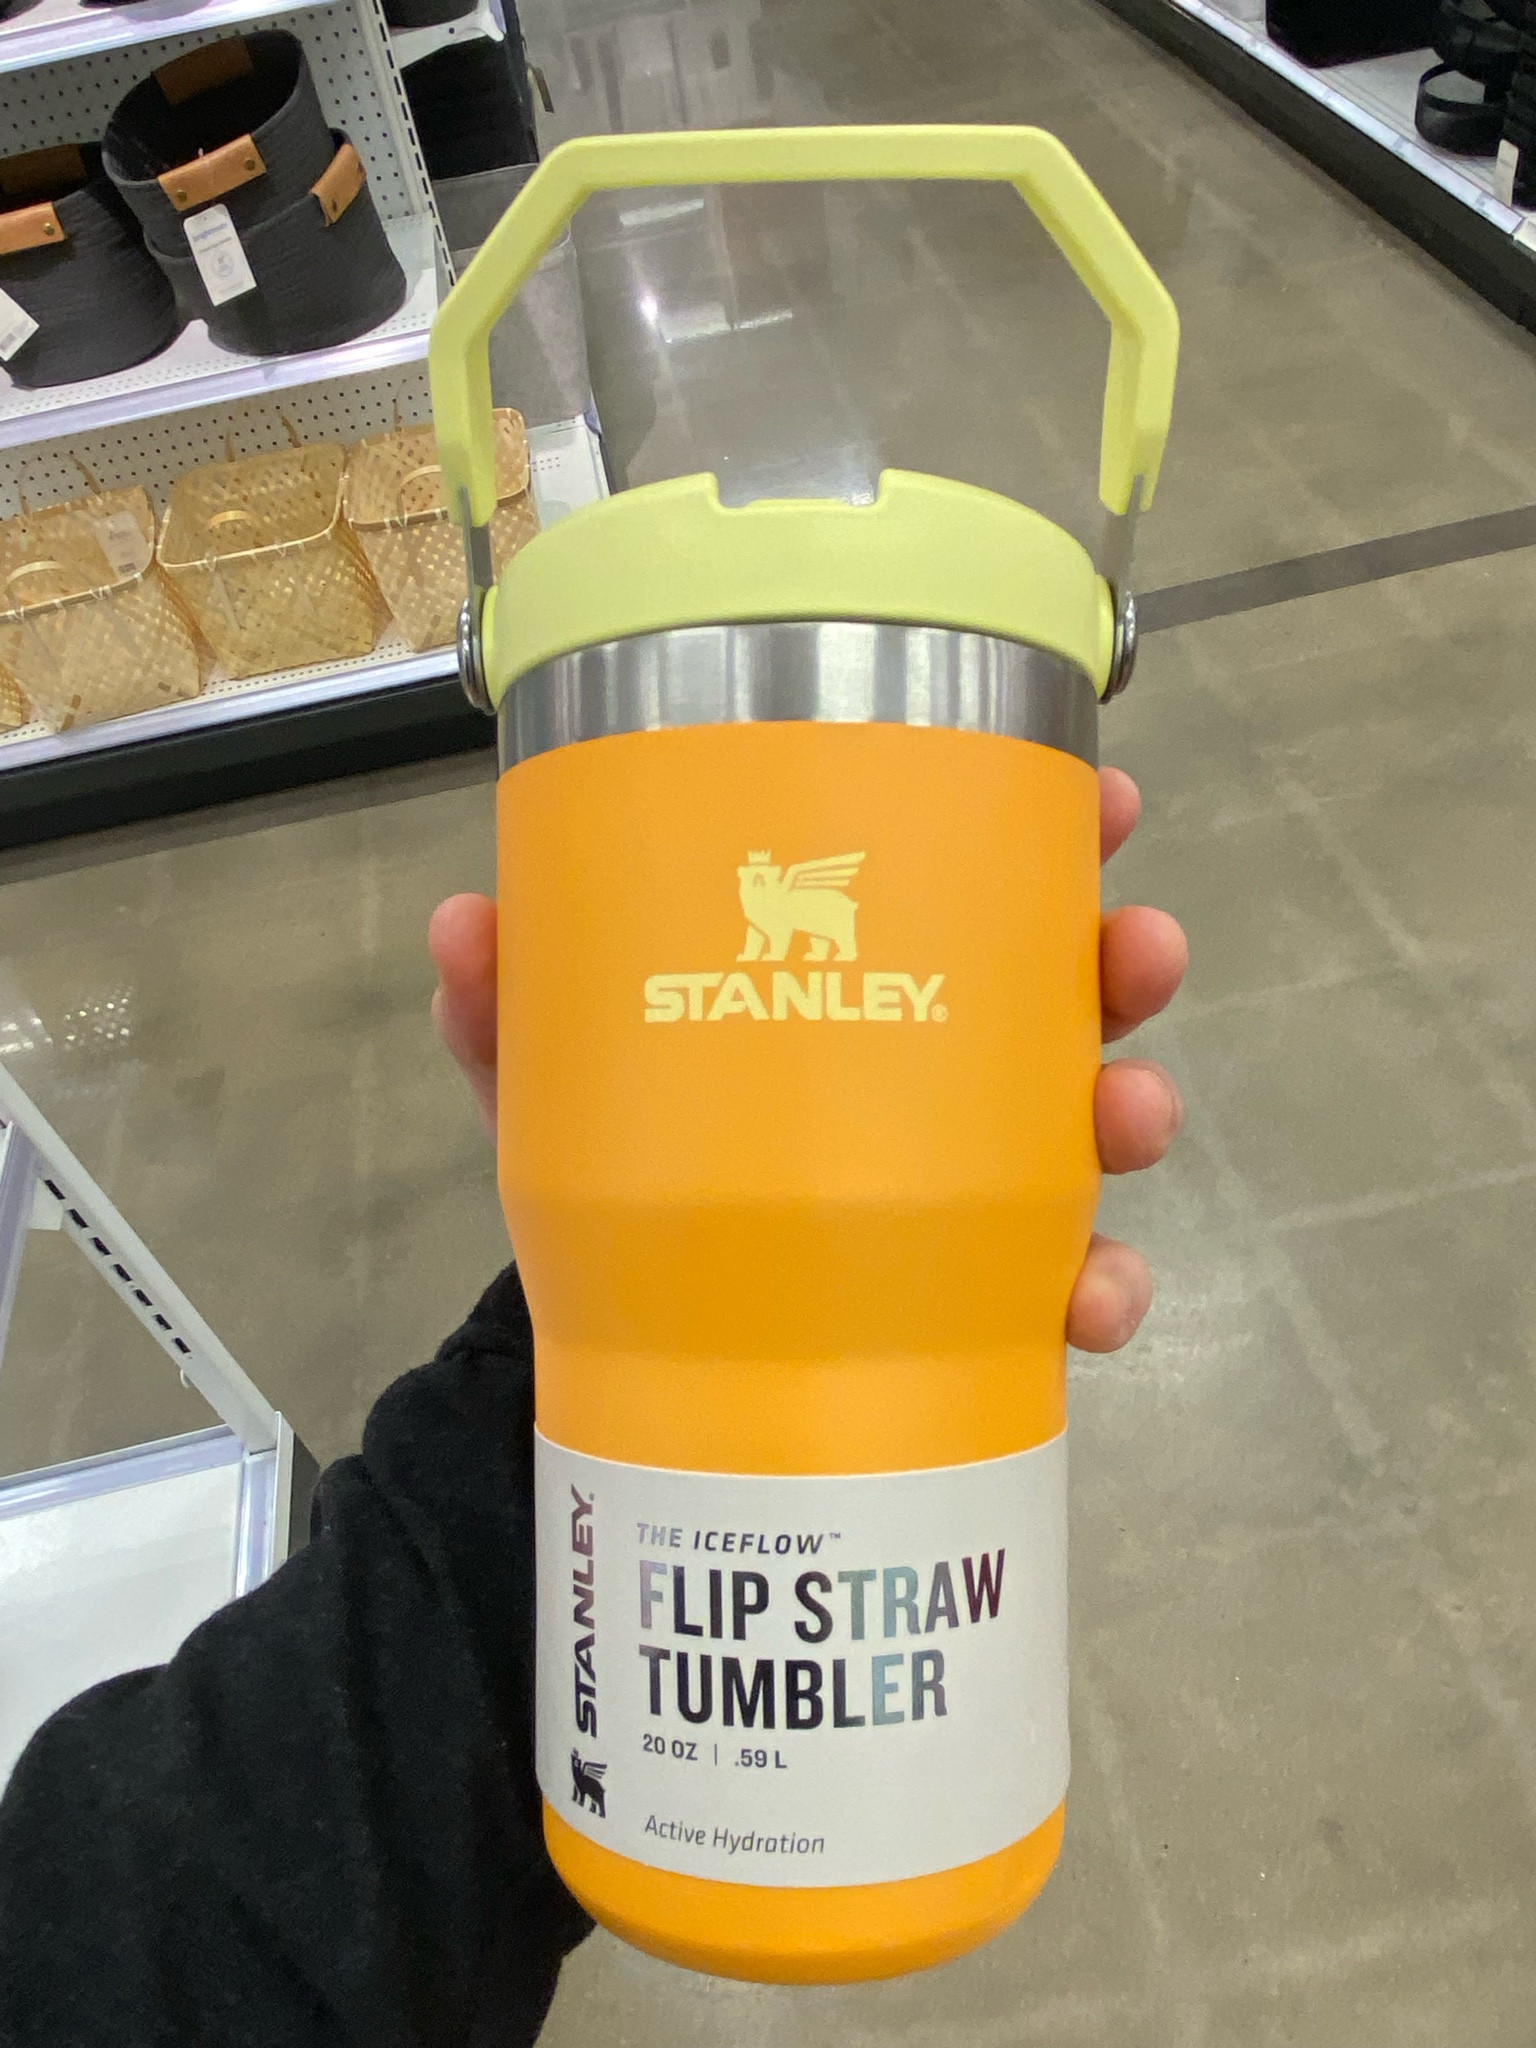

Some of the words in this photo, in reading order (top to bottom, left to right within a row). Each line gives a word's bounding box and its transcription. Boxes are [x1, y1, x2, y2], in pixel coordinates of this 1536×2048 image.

[637, 1523, 683, 1548] THE
[640, 1560, 769, 1641] FLIP
[794, 1548, 1006, 1643] STRAW
[638, 1643, 948, 1730] TUMBLER
[642, 1733, 666, 1755] 20
[671, 1740, 698, 1762] OZ
[734, 1748, 768, 1769] .59
[775, 1749, 788, 1769] L
[644, 1814, 706, 1846] Active
[713, 1827, 826, 1855] Hydration
